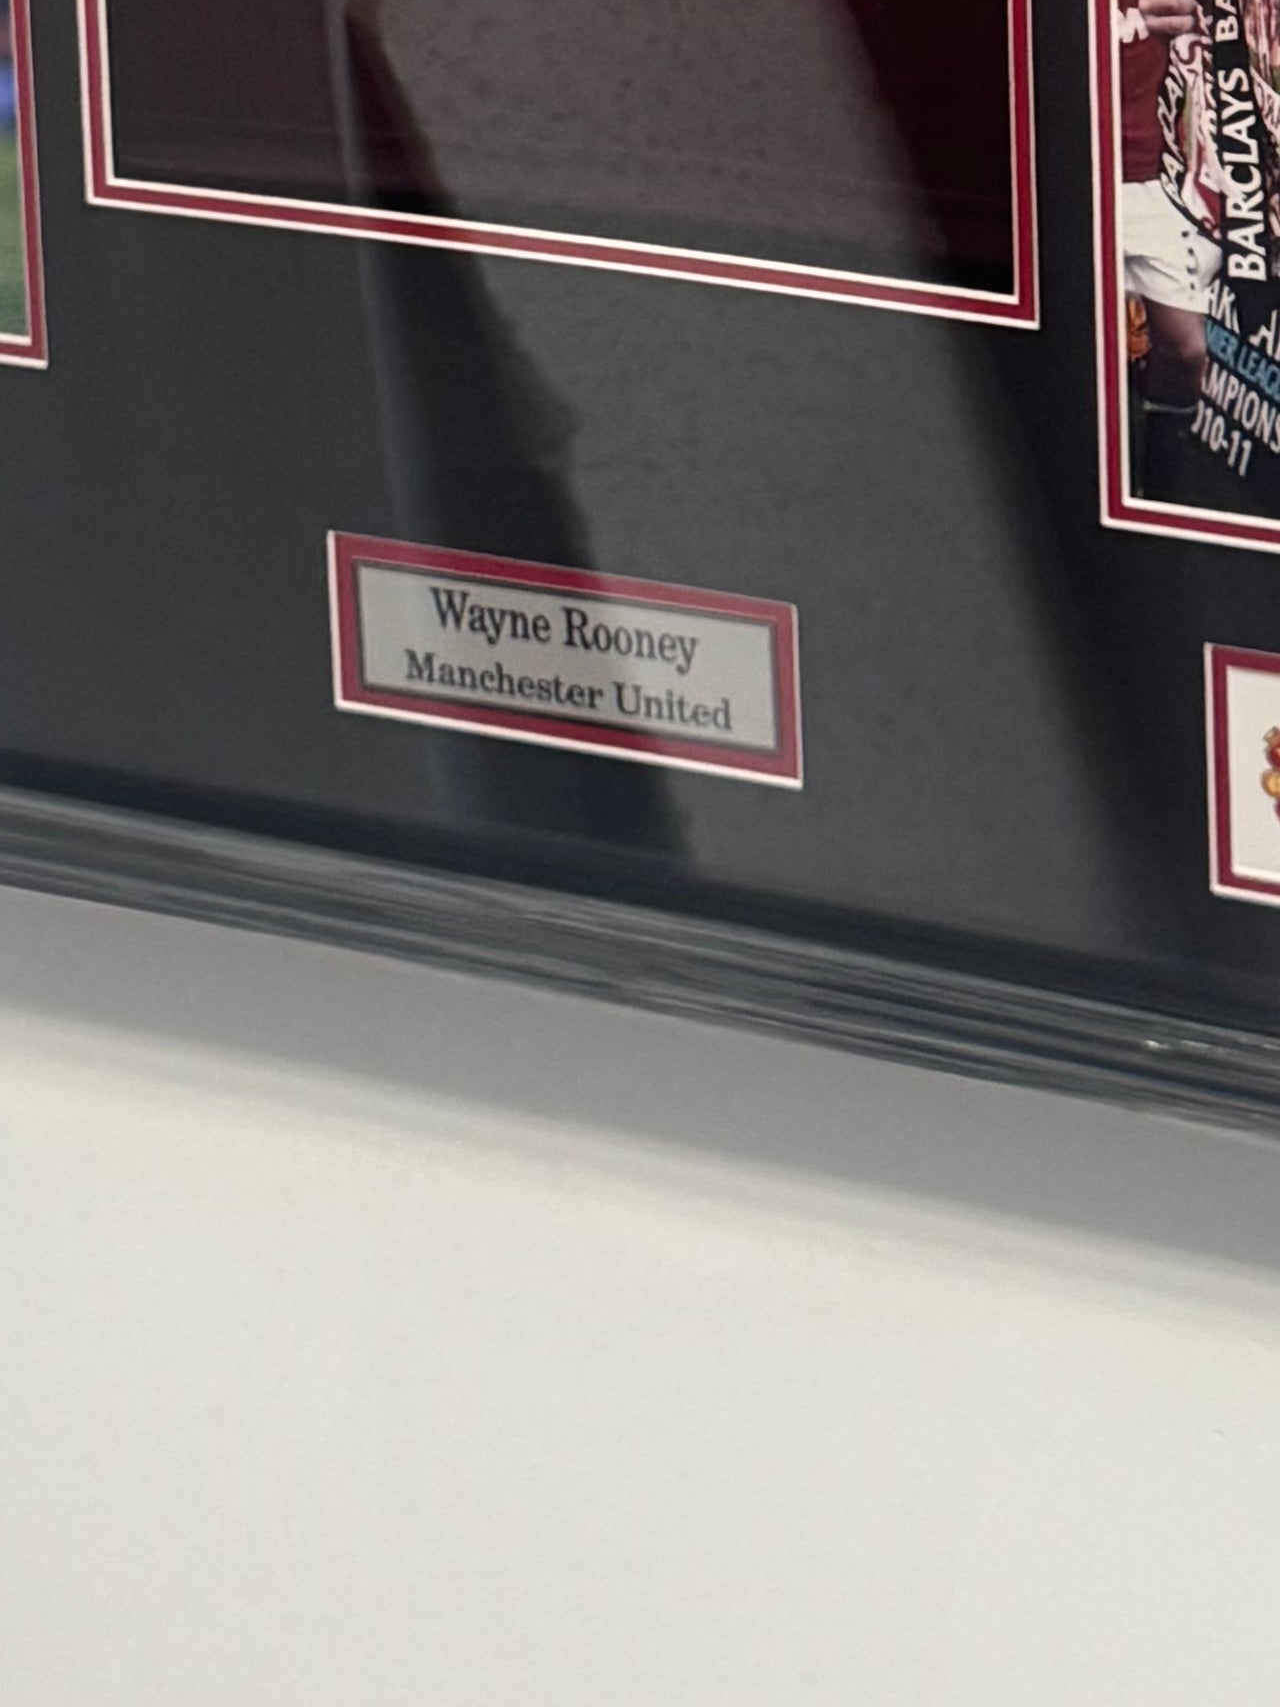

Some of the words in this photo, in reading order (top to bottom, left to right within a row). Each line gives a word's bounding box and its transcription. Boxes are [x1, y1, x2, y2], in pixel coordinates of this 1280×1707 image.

[1217, 67, 1267, 282] BARCLAYS
[430, 586, 552, 646] Wayne
[562, 606, 699, 674] Rooney
[404, 648, 604, 710] Manchester
[612, 681, 733, 732] United
